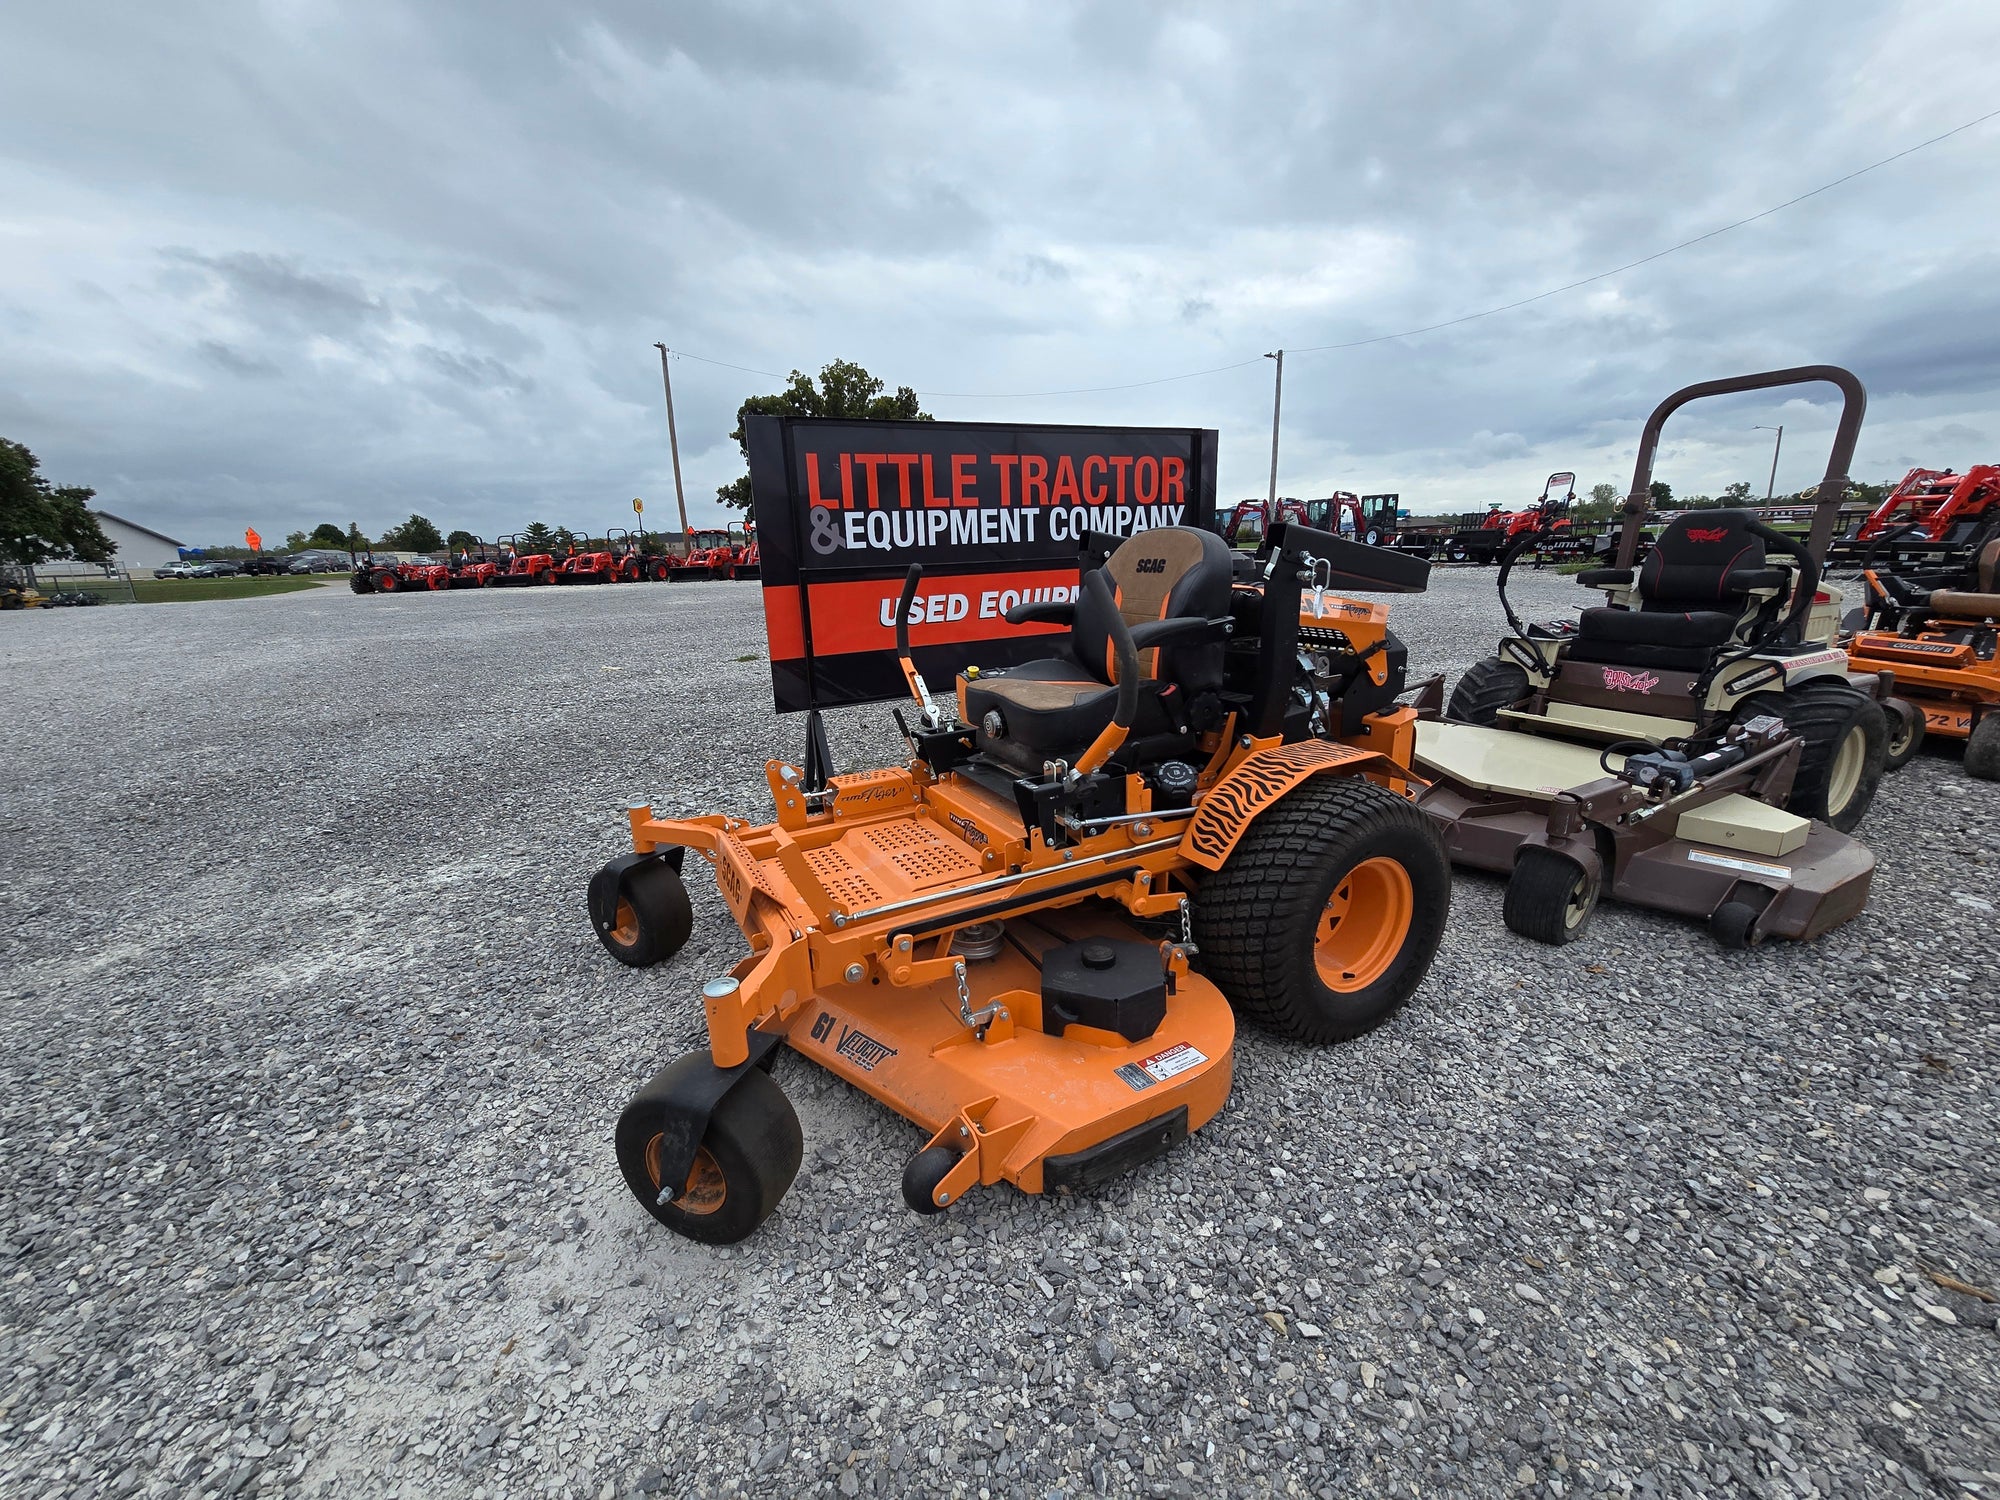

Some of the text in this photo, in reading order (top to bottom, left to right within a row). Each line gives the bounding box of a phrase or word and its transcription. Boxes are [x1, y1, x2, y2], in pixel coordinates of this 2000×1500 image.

[806, 453, 1185, 509] LITTLE TRACTOR
[844, 508, 1040, 551] EQUIPMENT
[1050, 505, 1185, 542] COMPANY
[1136, 558, 1167, 573] SCAG
[880, 585, 1080, 627] USED EQUIP
[1893, 642, 1941, 653] CHEETAH
[1926, 713, 1950, 726] 72
[721, 855, 741, 905] SCAG
[811, 1011, 837, 1044] 61
[1154, 1044, 1187, 1061] DANGER
